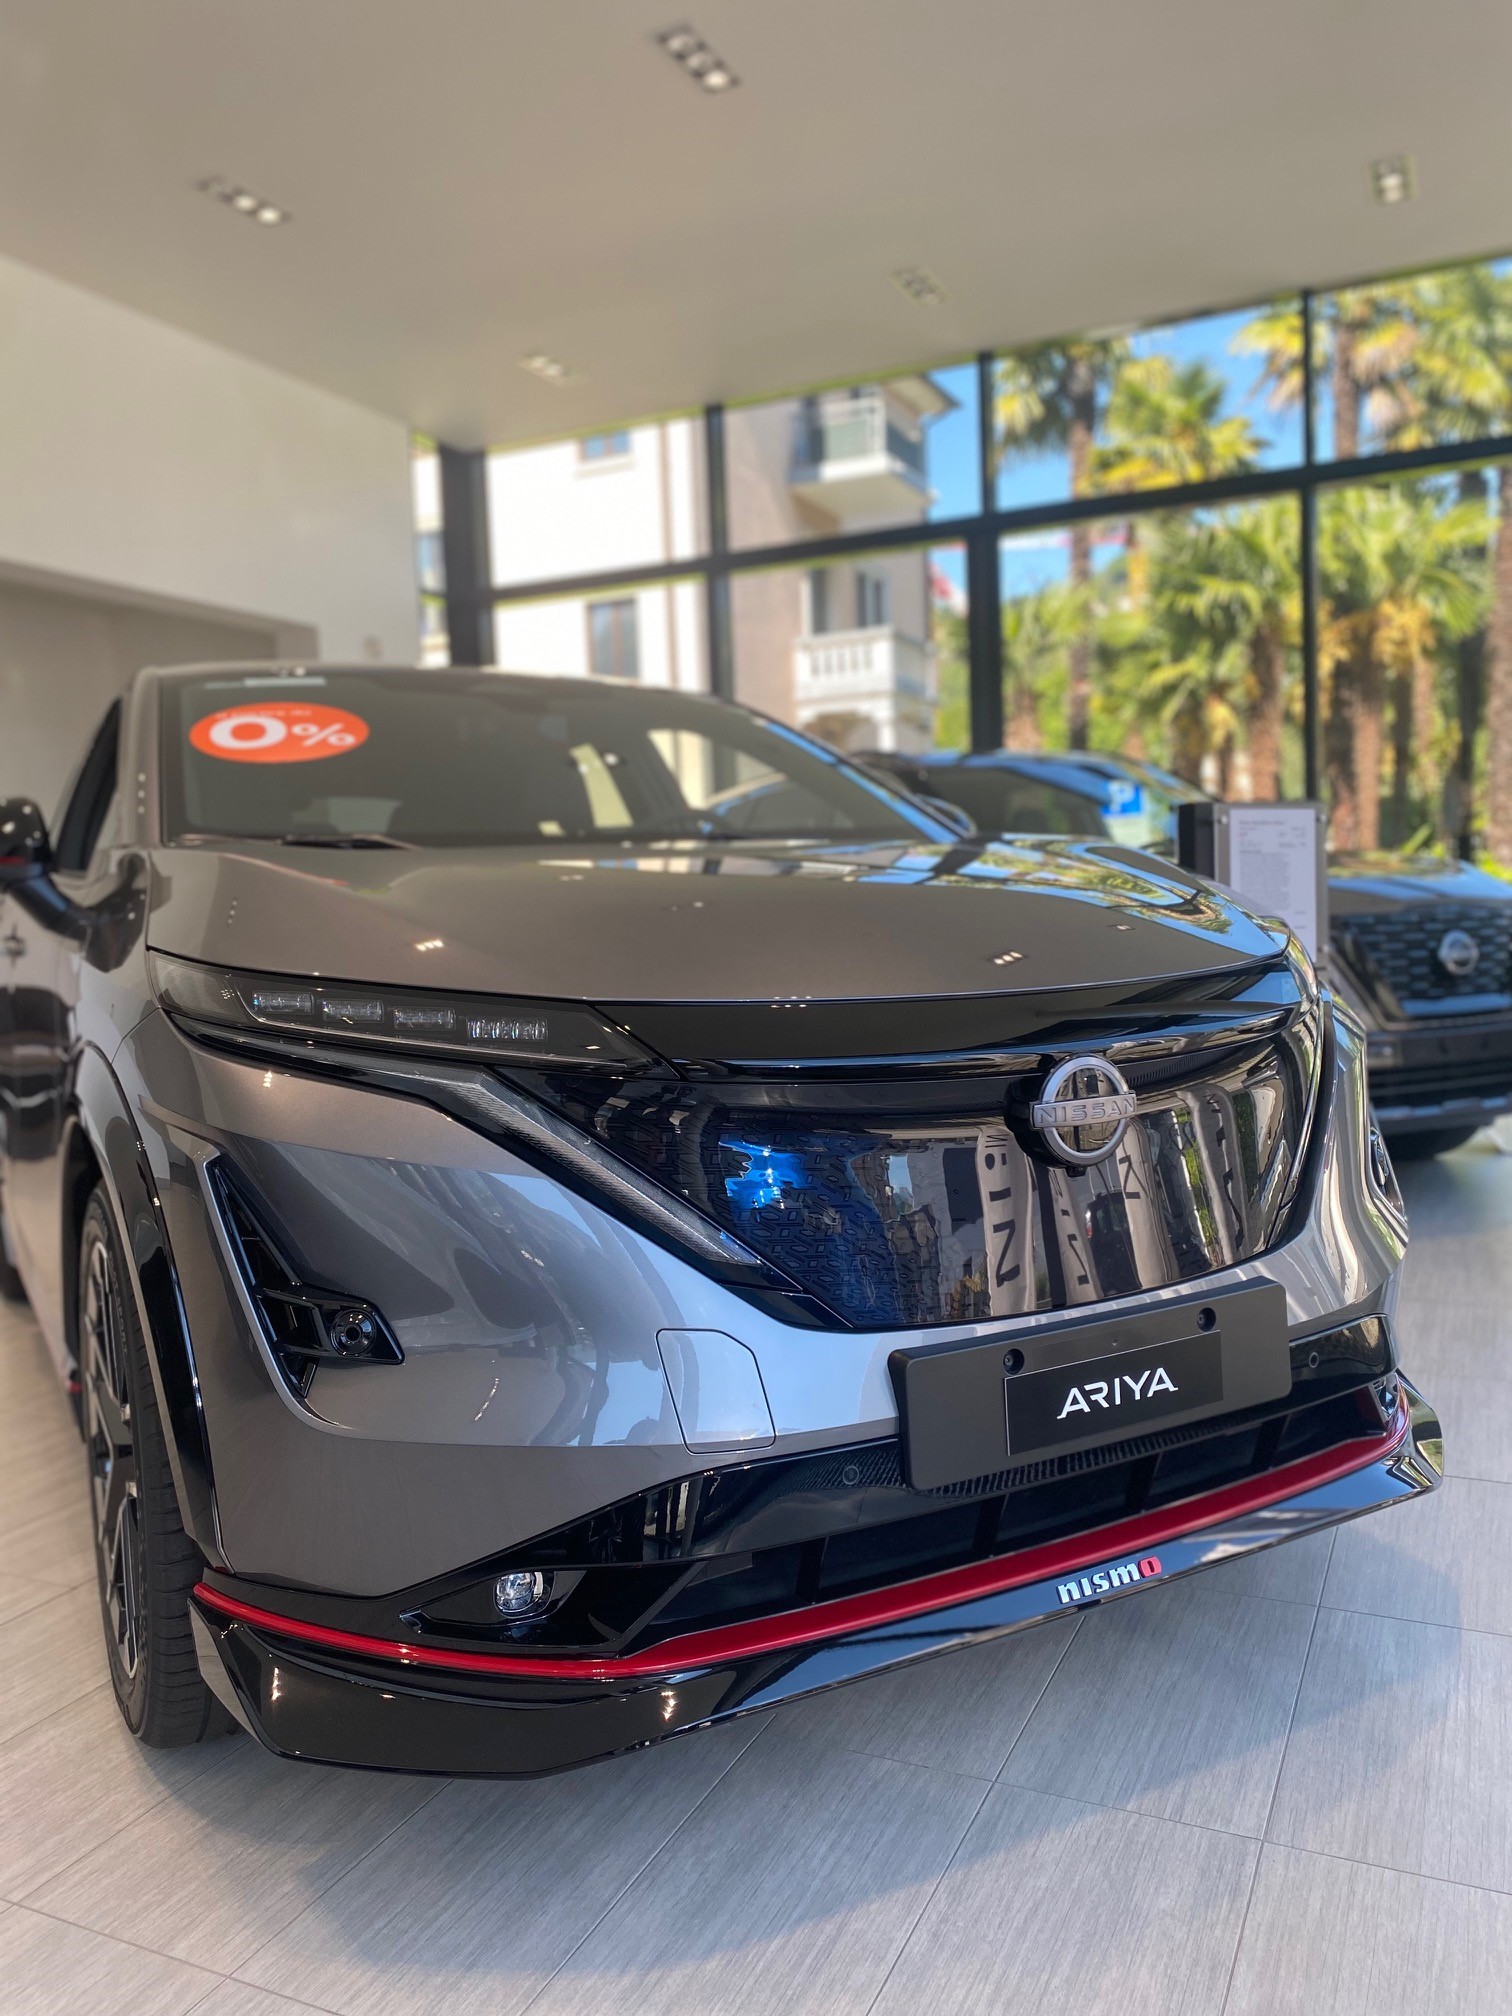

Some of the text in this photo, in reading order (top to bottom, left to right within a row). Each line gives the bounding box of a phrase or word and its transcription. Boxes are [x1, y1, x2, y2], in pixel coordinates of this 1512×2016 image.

[208, 714, 356, 750] 0%
[1038, 1096, 1137, 1125] NISSAN
[1056, 1367, 1179, 1419] ARIYA
[1056, 1555, 1162, 1604] nismo
